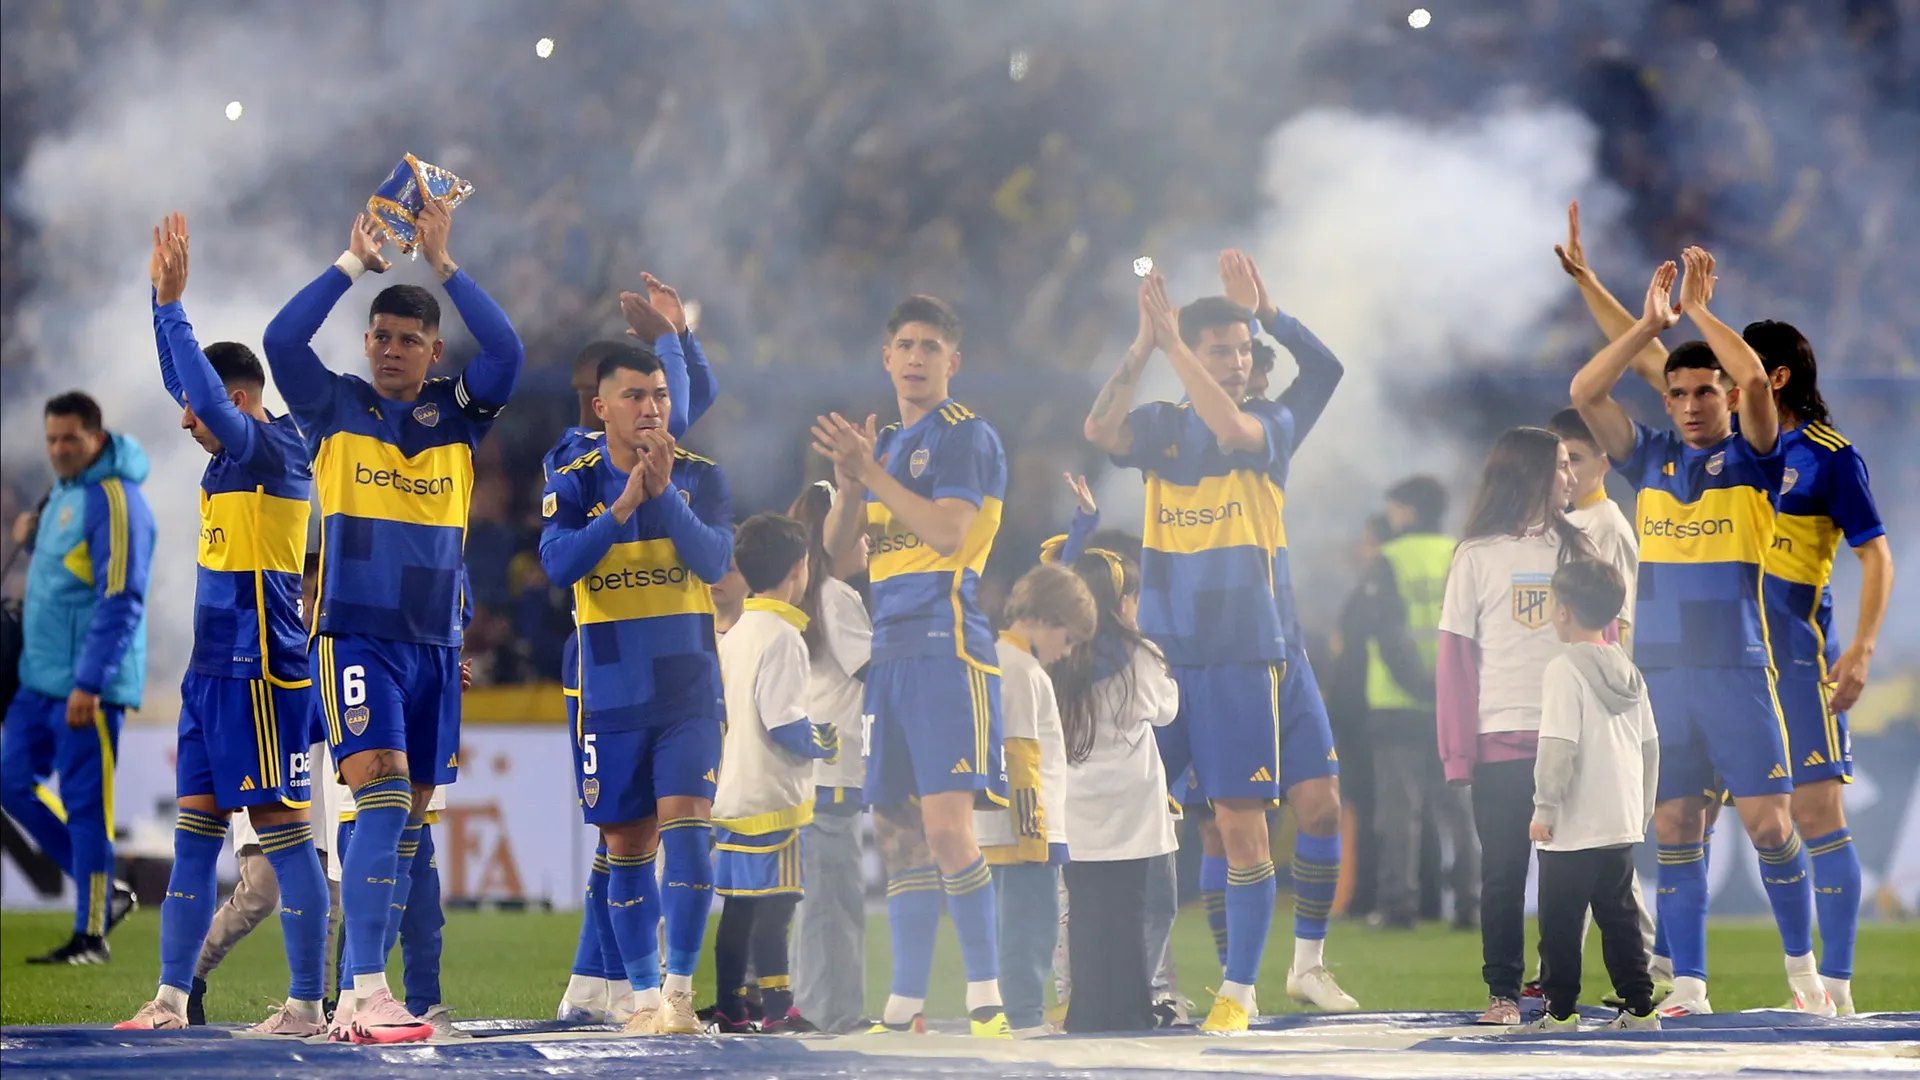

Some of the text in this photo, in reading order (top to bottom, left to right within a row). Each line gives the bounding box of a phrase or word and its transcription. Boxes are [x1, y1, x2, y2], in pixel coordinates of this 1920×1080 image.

[355, 462, 454, 495] betsson
[1643, 516, 1734, 539] betsson
[343, 664, 366, 707] 6
[583, 733, 598, 775] 5
